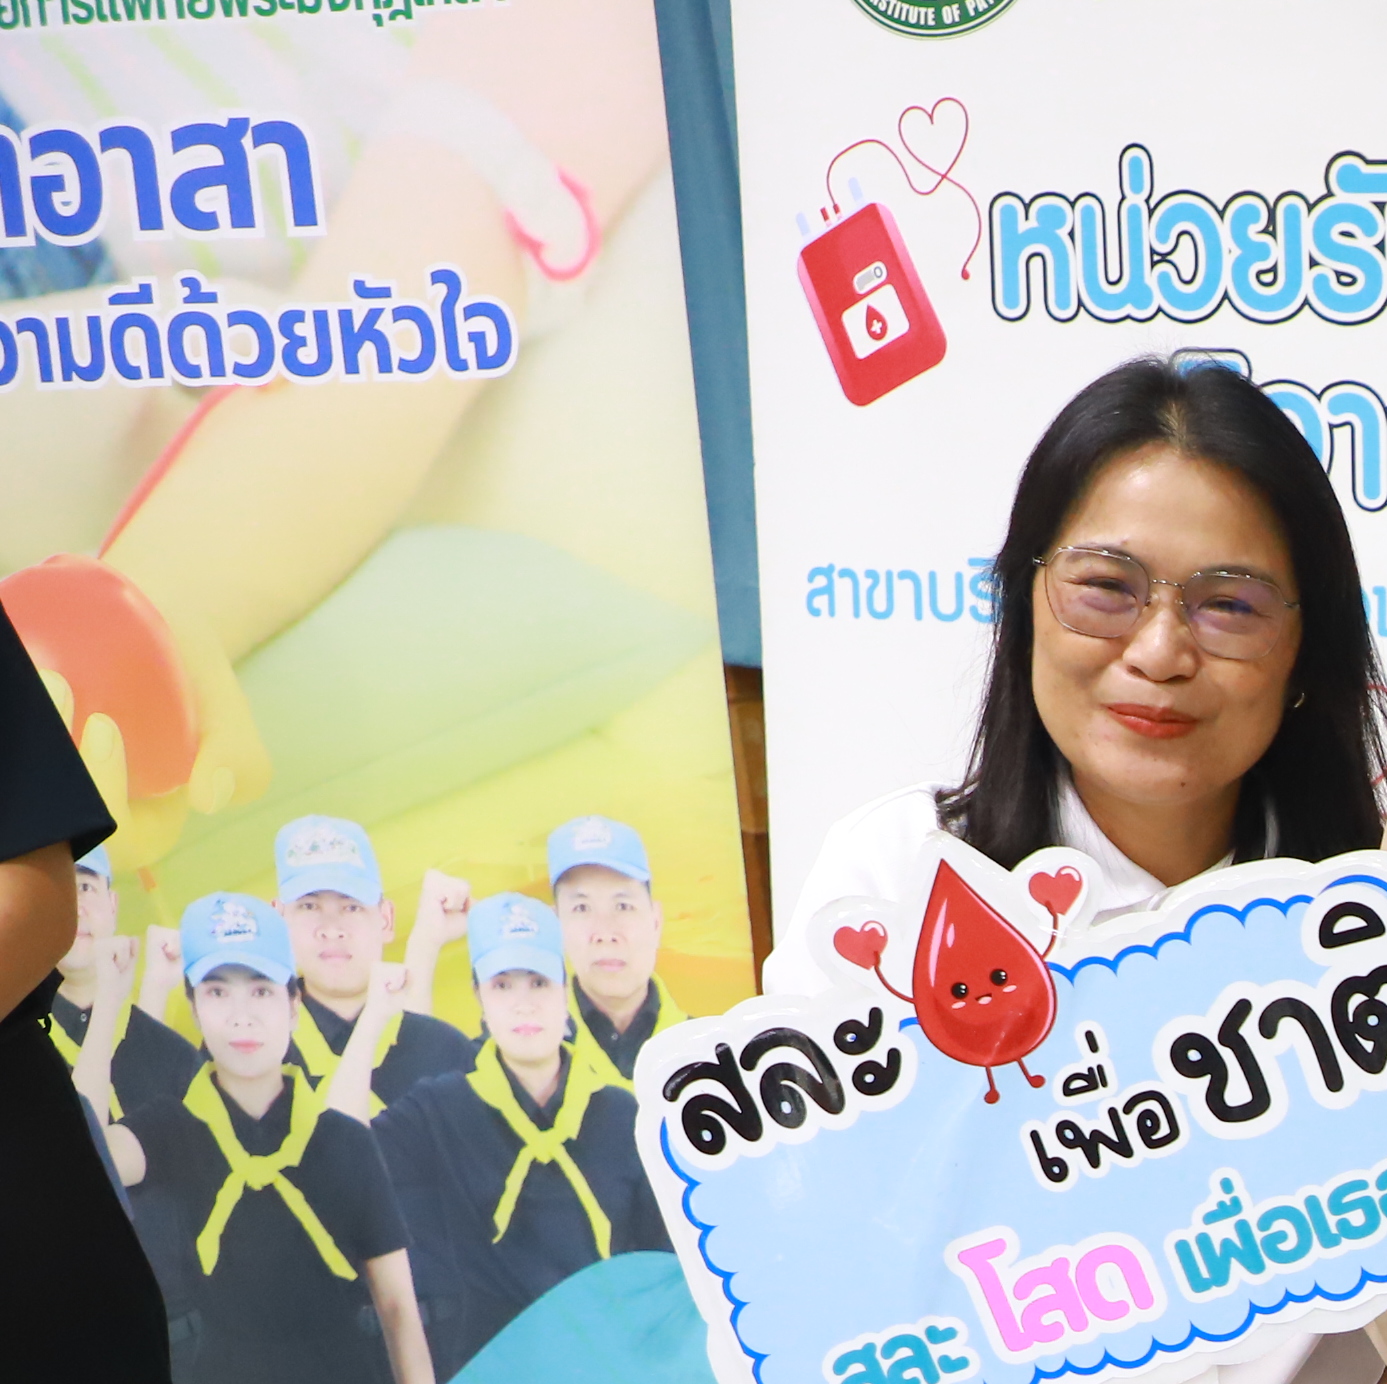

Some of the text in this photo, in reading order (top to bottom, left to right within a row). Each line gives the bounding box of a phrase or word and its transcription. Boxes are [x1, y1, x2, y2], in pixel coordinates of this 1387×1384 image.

[869, 0, 936, 25] STITUTE
[941, 3, 961, 25] OF
[663, 1006, 902, 1156] สละ
[1027, 1029, 1180, 1183] เพื่อ
[956, 1238, 1154, 1353] โสด
